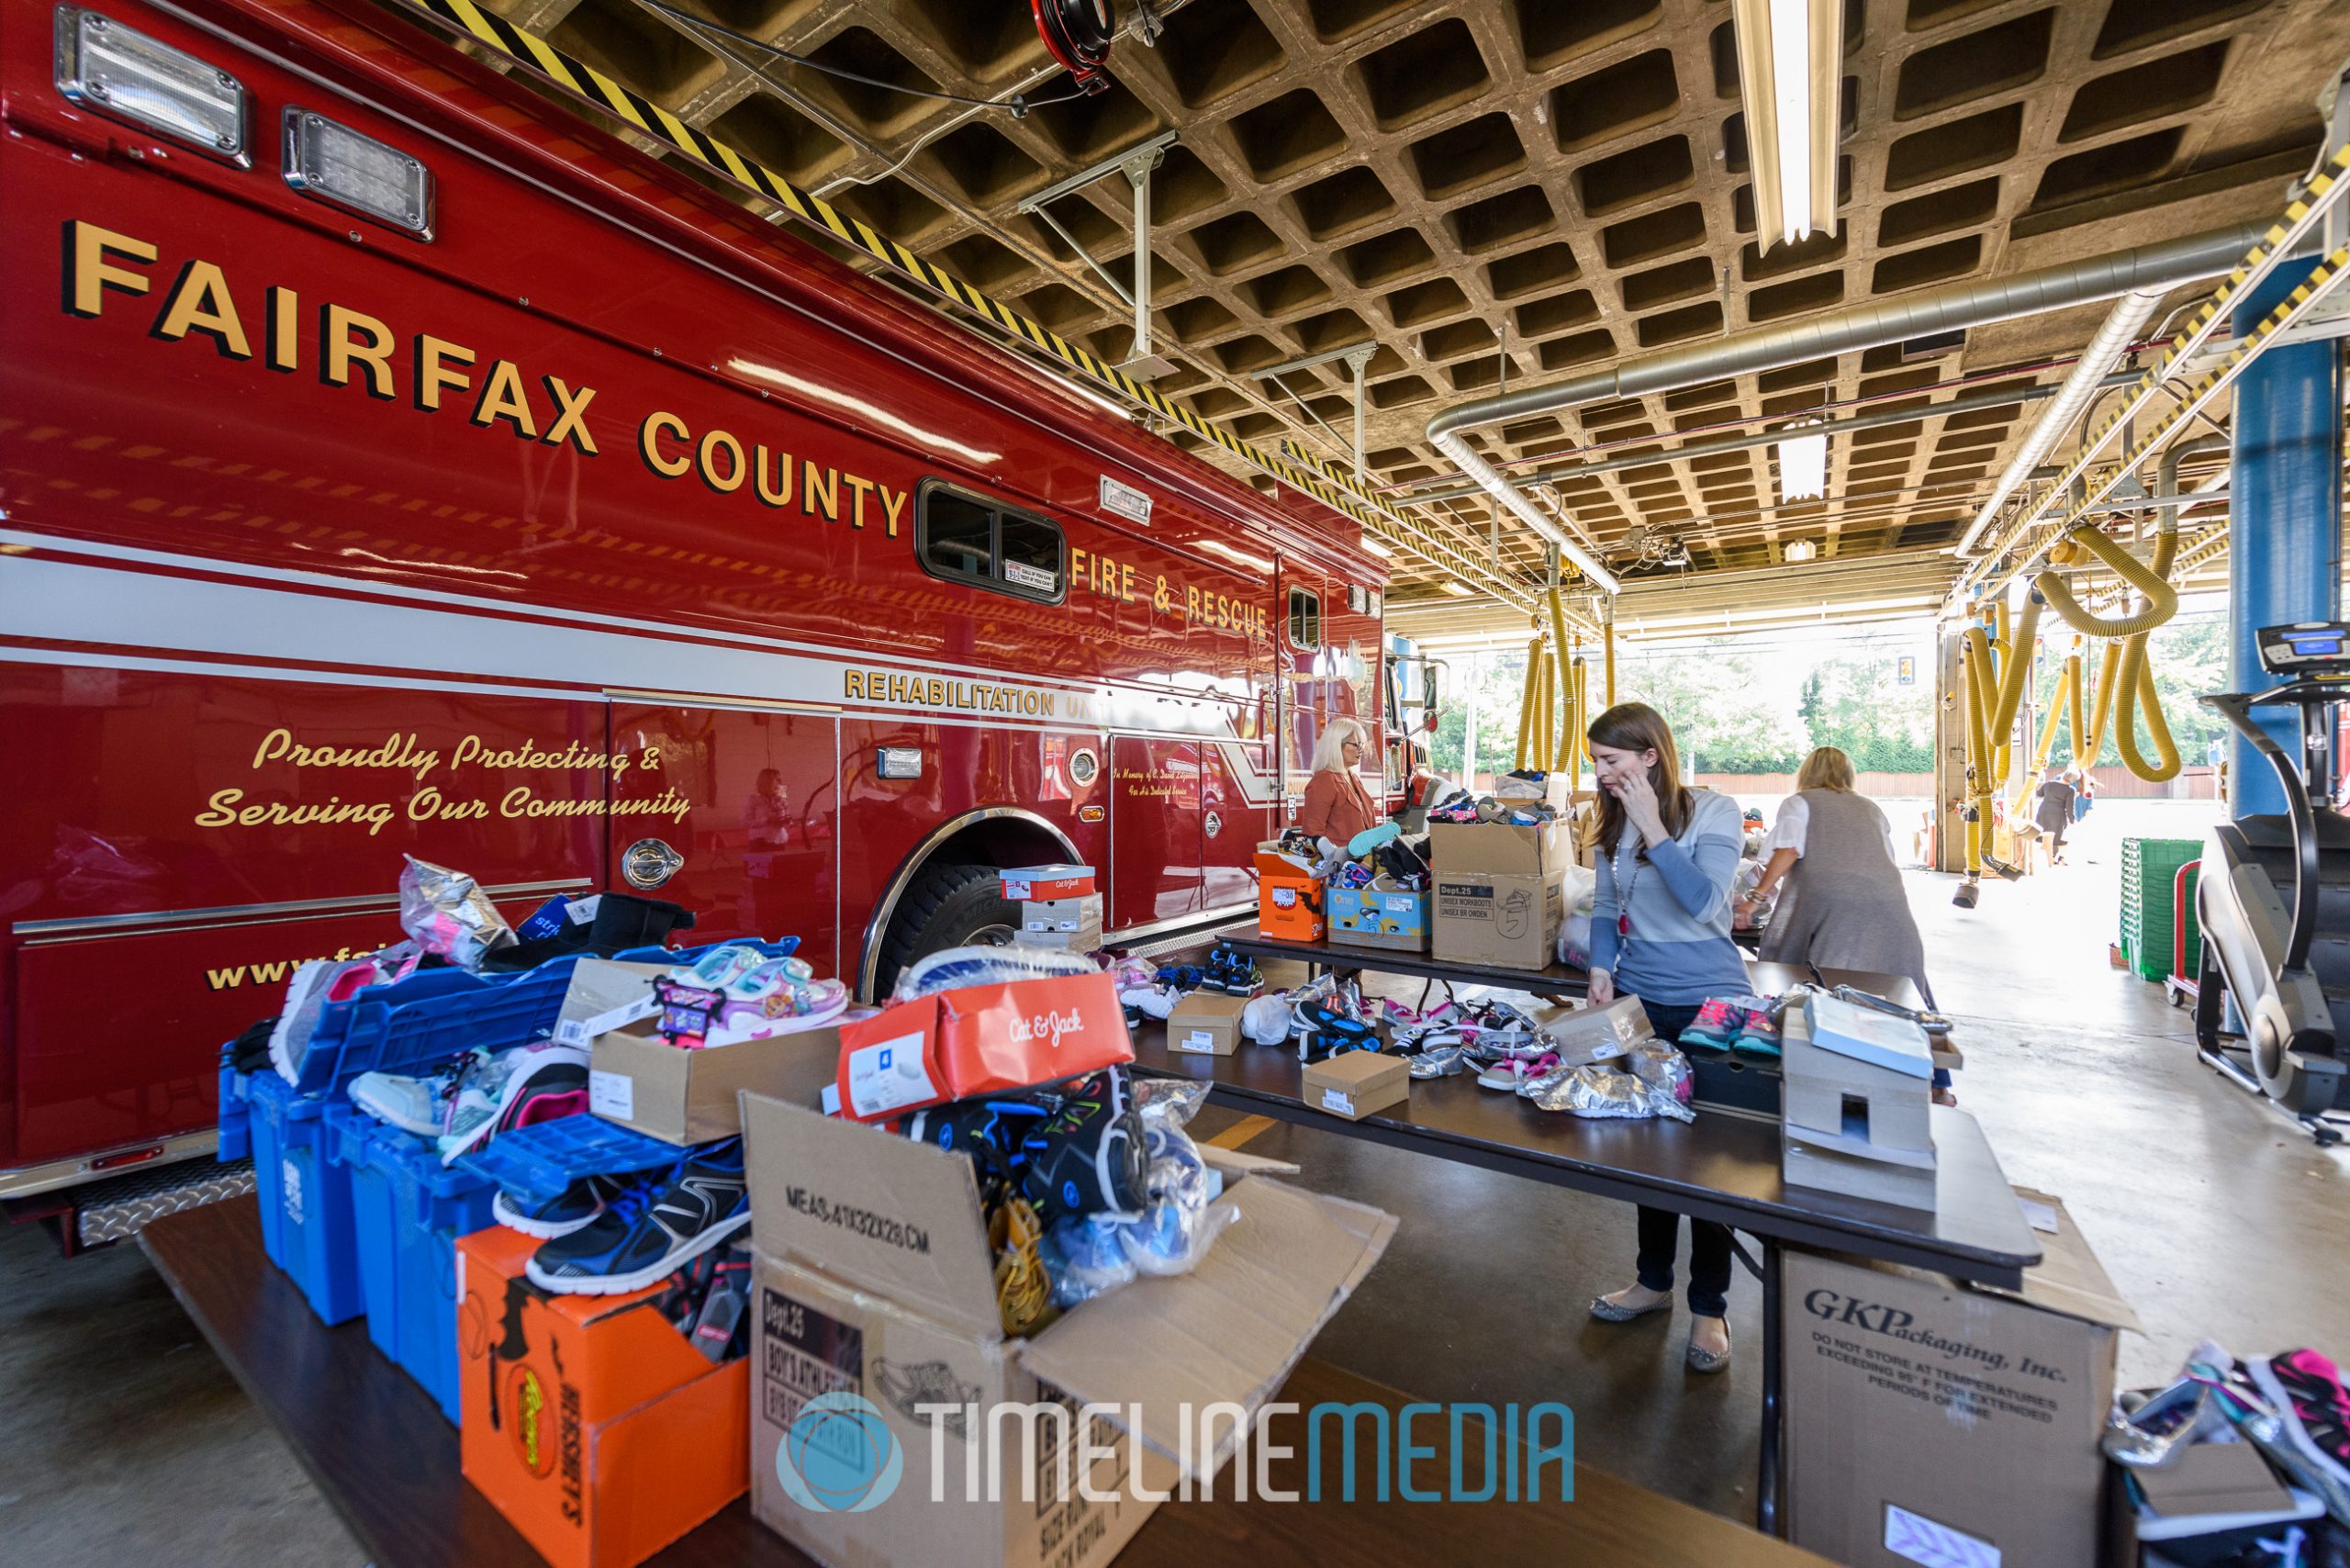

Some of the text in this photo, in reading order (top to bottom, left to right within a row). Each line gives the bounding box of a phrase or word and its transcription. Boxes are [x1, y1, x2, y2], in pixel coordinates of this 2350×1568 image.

[62, 218, 908, 540] FAIRFAX COUNTY
[1070, 547, 1267, 639] FIRE & RESCUE
[845, 669, 1055, 715] REHABILITATION
[252, 728, 660, 781] Proudly Protecting &
[1123, 768, 1144, 782] Memory
[194, 786, 690, 835] Serving Our Community
[1441, 886, 1471, 895] Dept.25
[1441, 897, 1491, 907] UNISEX WORKBOOTS
[1441, 908, 1459, 916] UNISEX
[1009, 1008, 1084, 1047] Cat & Jack
[1812, 1331, 2058, 1412] DO NOT STORE AT TEMPERATURES
[1817, 1345, 1894, 1377] EXCEEDING
[1934, 1382, 1965, 1398] FOR
[1969, 1392, 2053, 1423] EXTENDED
[2019, 1356, 2067, 1383] Inc.
[1868, 1374, 1992, 1420] PERIODS OF TIME
